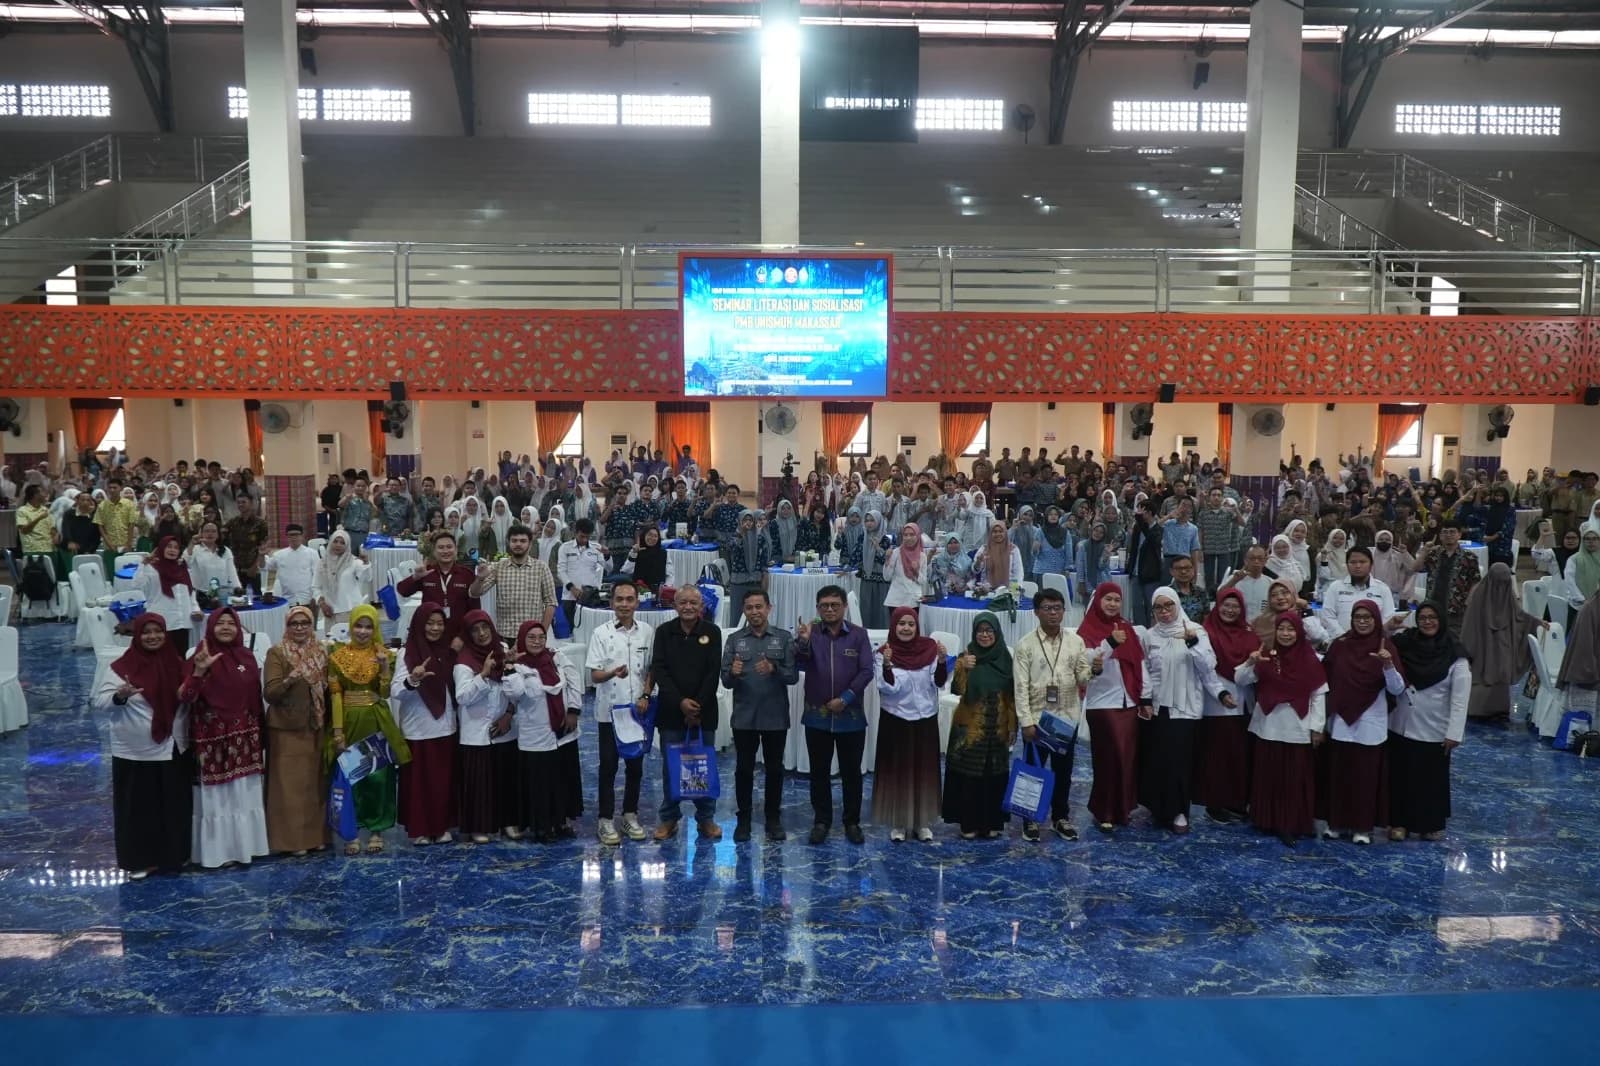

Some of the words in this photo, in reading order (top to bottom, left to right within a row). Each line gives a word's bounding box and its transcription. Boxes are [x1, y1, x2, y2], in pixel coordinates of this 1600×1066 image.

[712, 299, 752, 312] SEMINAR
[753, 299, 792, 312] LITERASI
[793, 299, 810, 312] DAN
[812, 299, 863, 312] SOSIALISASI
[755, 316, 793, 329] UNISMUH
[796, 316, 842, 329] MAKASSAR
